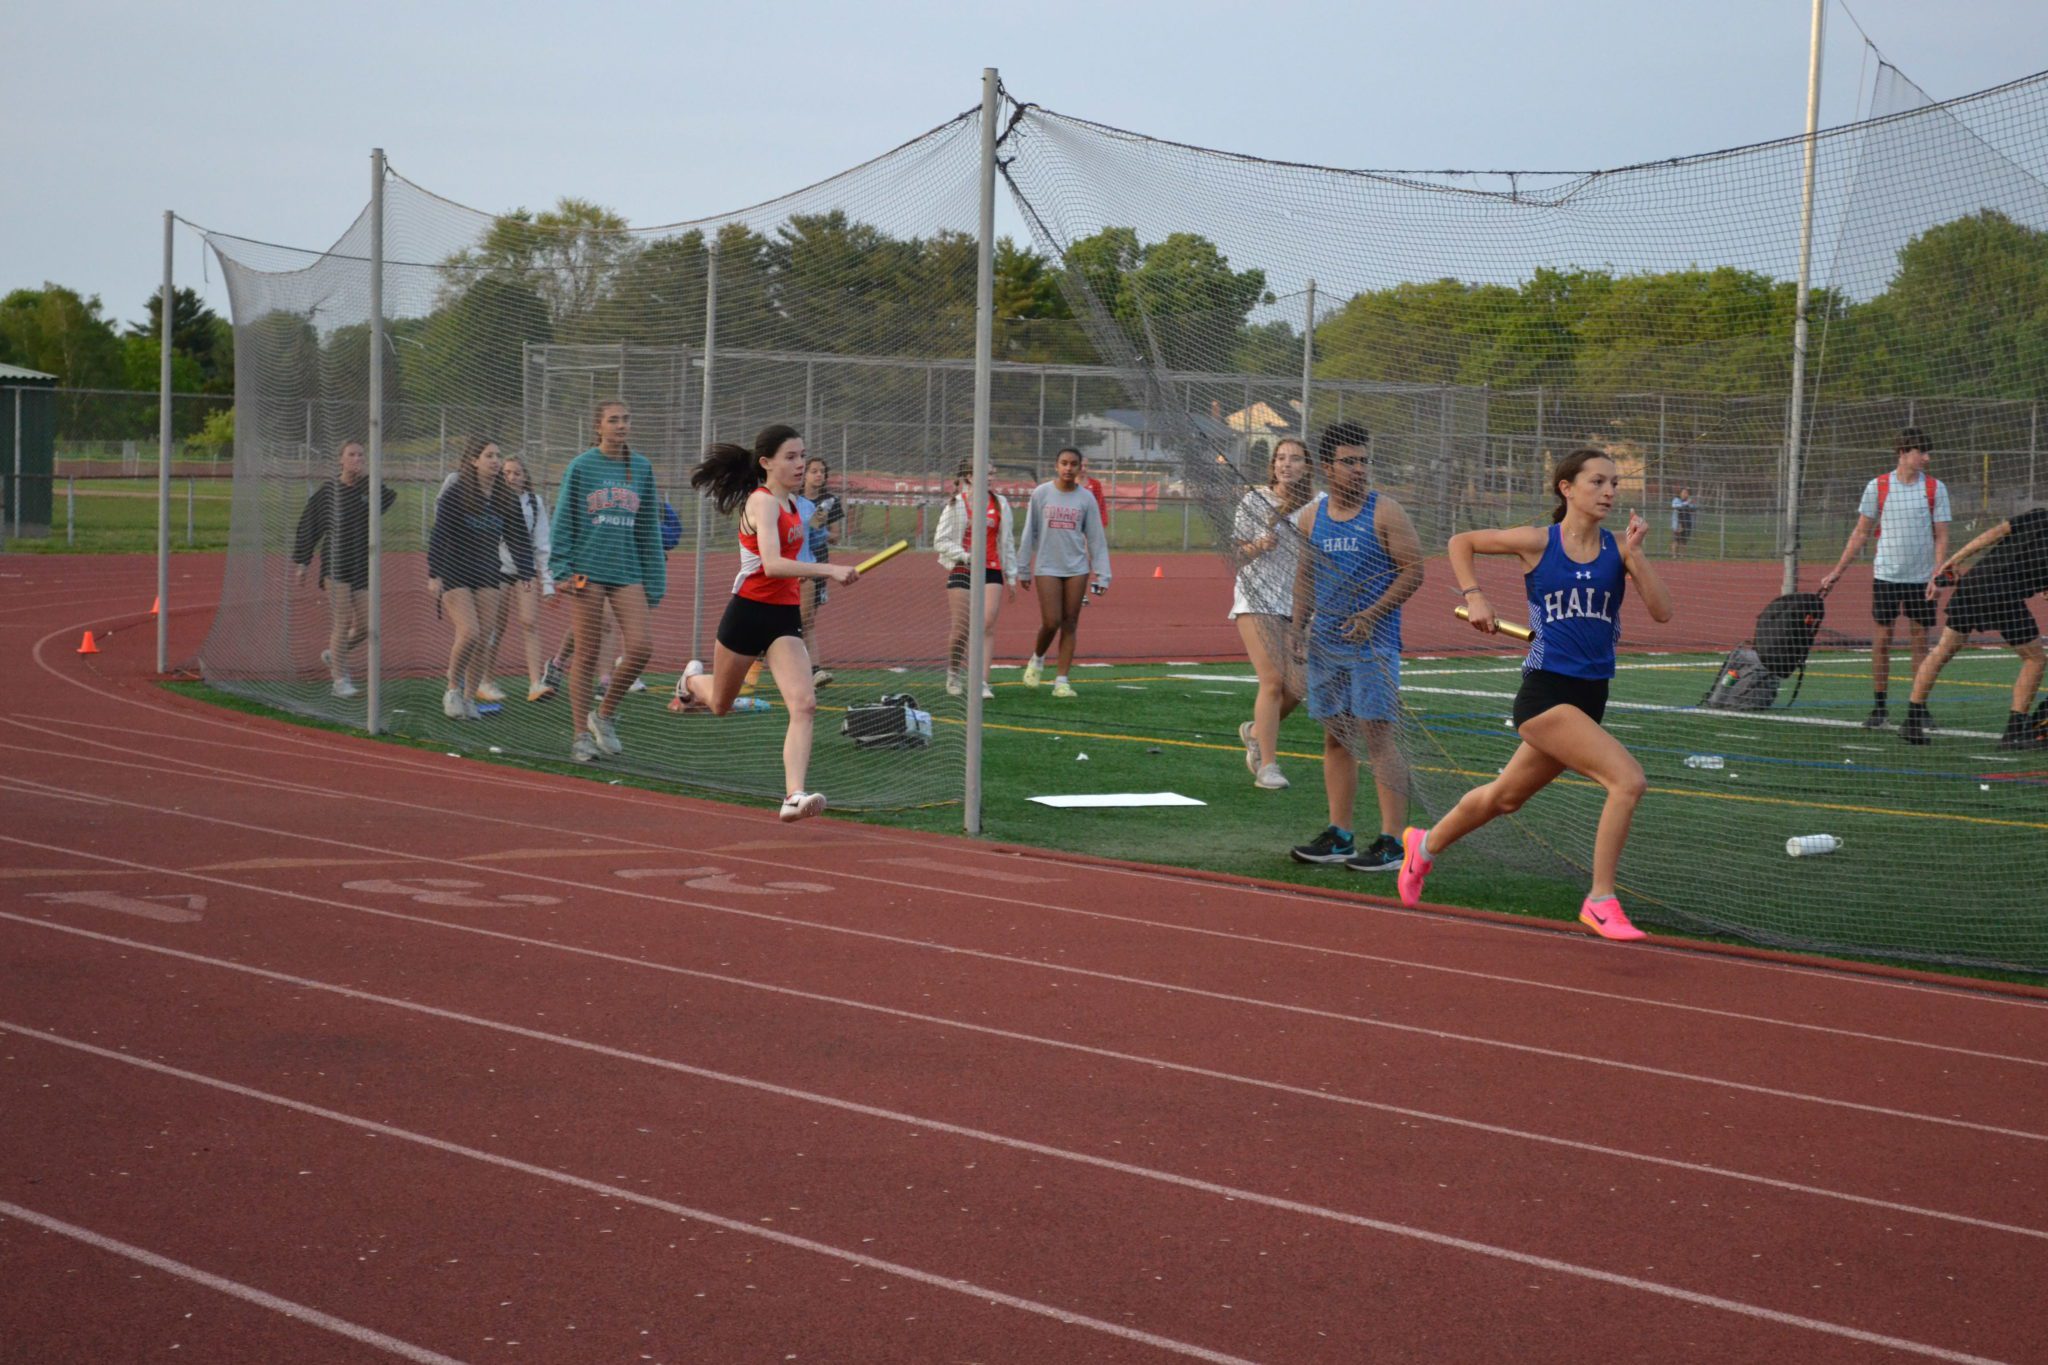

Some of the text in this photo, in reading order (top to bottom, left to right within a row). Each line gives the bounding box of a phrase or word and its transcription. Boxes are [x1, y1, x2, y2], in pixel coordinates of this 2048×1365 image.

[1323, 537, 1359, 552] HALL
[1543, 587, 1612, 623] HALL
[342, 878, 563, 908] 3
[612, 866, 836, 894] 2
[24, 890, 207, 923] 4
